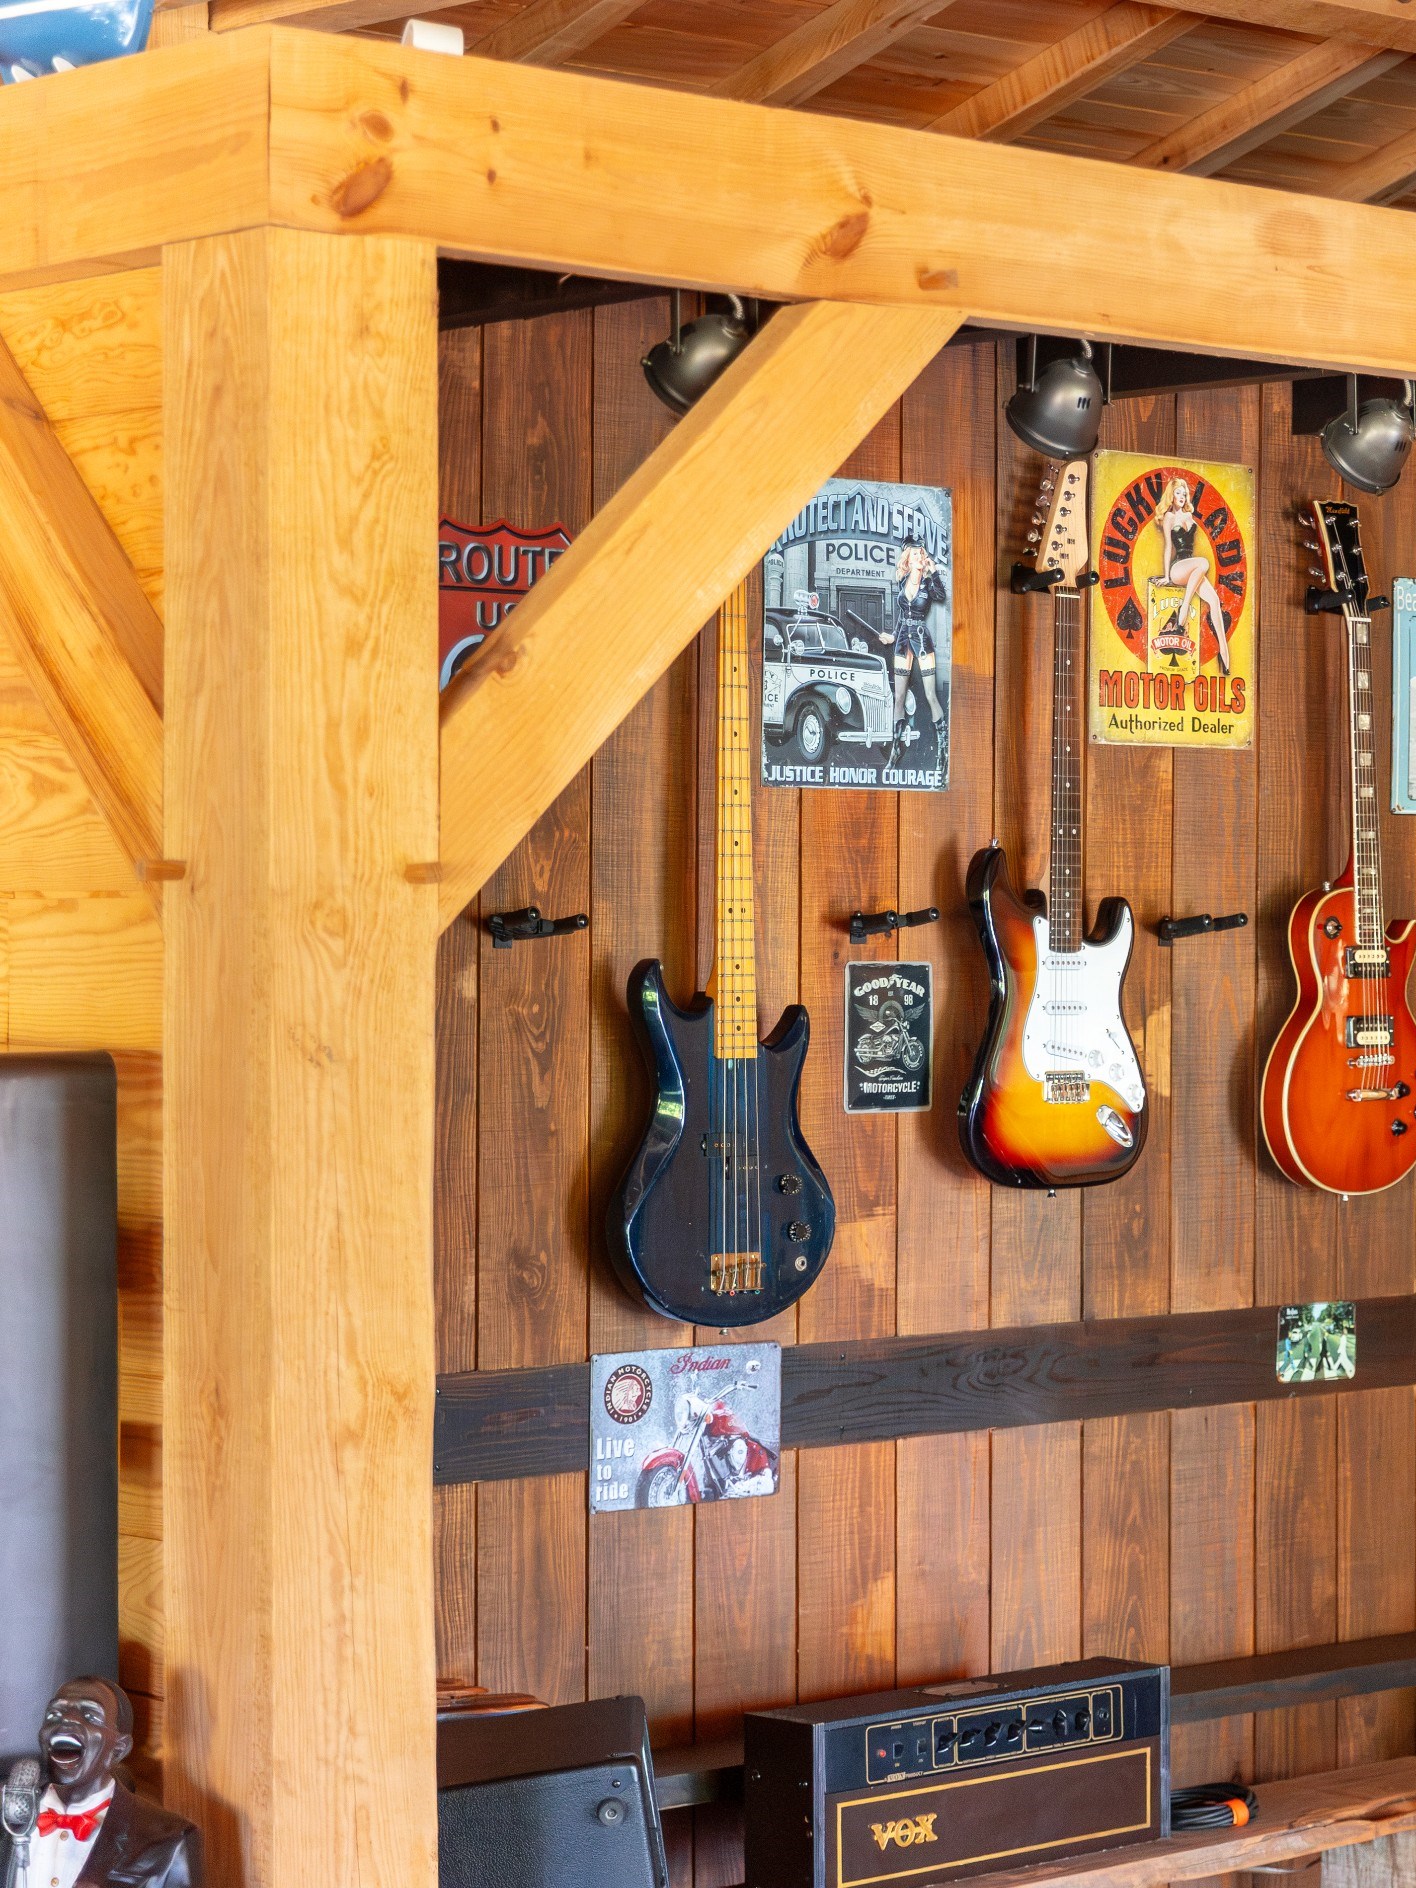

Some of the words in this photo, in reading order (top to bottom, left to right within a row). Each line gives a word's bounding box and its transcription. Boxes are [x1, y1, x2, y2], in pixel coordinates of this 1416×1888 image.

[771, 494, 849, 551] OTECT
[851, 494, 889, 534] AND
[892, 502, 948, 564] SERVE
[1103, 473, 1164, 589] LUCKY
[1191, 481, 1245, 596] LADY
[825, 542, 896, 566] POLICE
[836, 567, 885, 577] DEPARTMENT
[1154, 637, 1180, 649] MOTOR
[1181, 640, 1192, 651] OIL
[810, 669, 855, 681] POLICE
[1099, 669, 1186, 711] MOTOR
[1193, 674, 1246, 714] OILS
[1108, 713, 1184, 734] Authorized
[1191, 716, 1235, 734] Dealer
[768, 765, 824, 783] JUSTICE
[829, 766, 877, 784] HONOR
[882, 768, 943, 787] COURAGE
[868, 994, 879, 1006] 18
[903, 994, 914, 1006] 98
[863, 1081, 917, 1093] MOTORCYCLE
[669, 1352, 731, 1375] Indian
[605, 1375, 617, 1414] INDIAN
[618, 1366, 652, 1411] MOTORCYCLE
[619, 1414, 637, 1423] 1901
[596, 1437, 635, 1460] Live
[596, 1464, 612, 1480] to
[596, 1481, 629, 1502] ride
[870, 1812, 939, 1851] VOX
